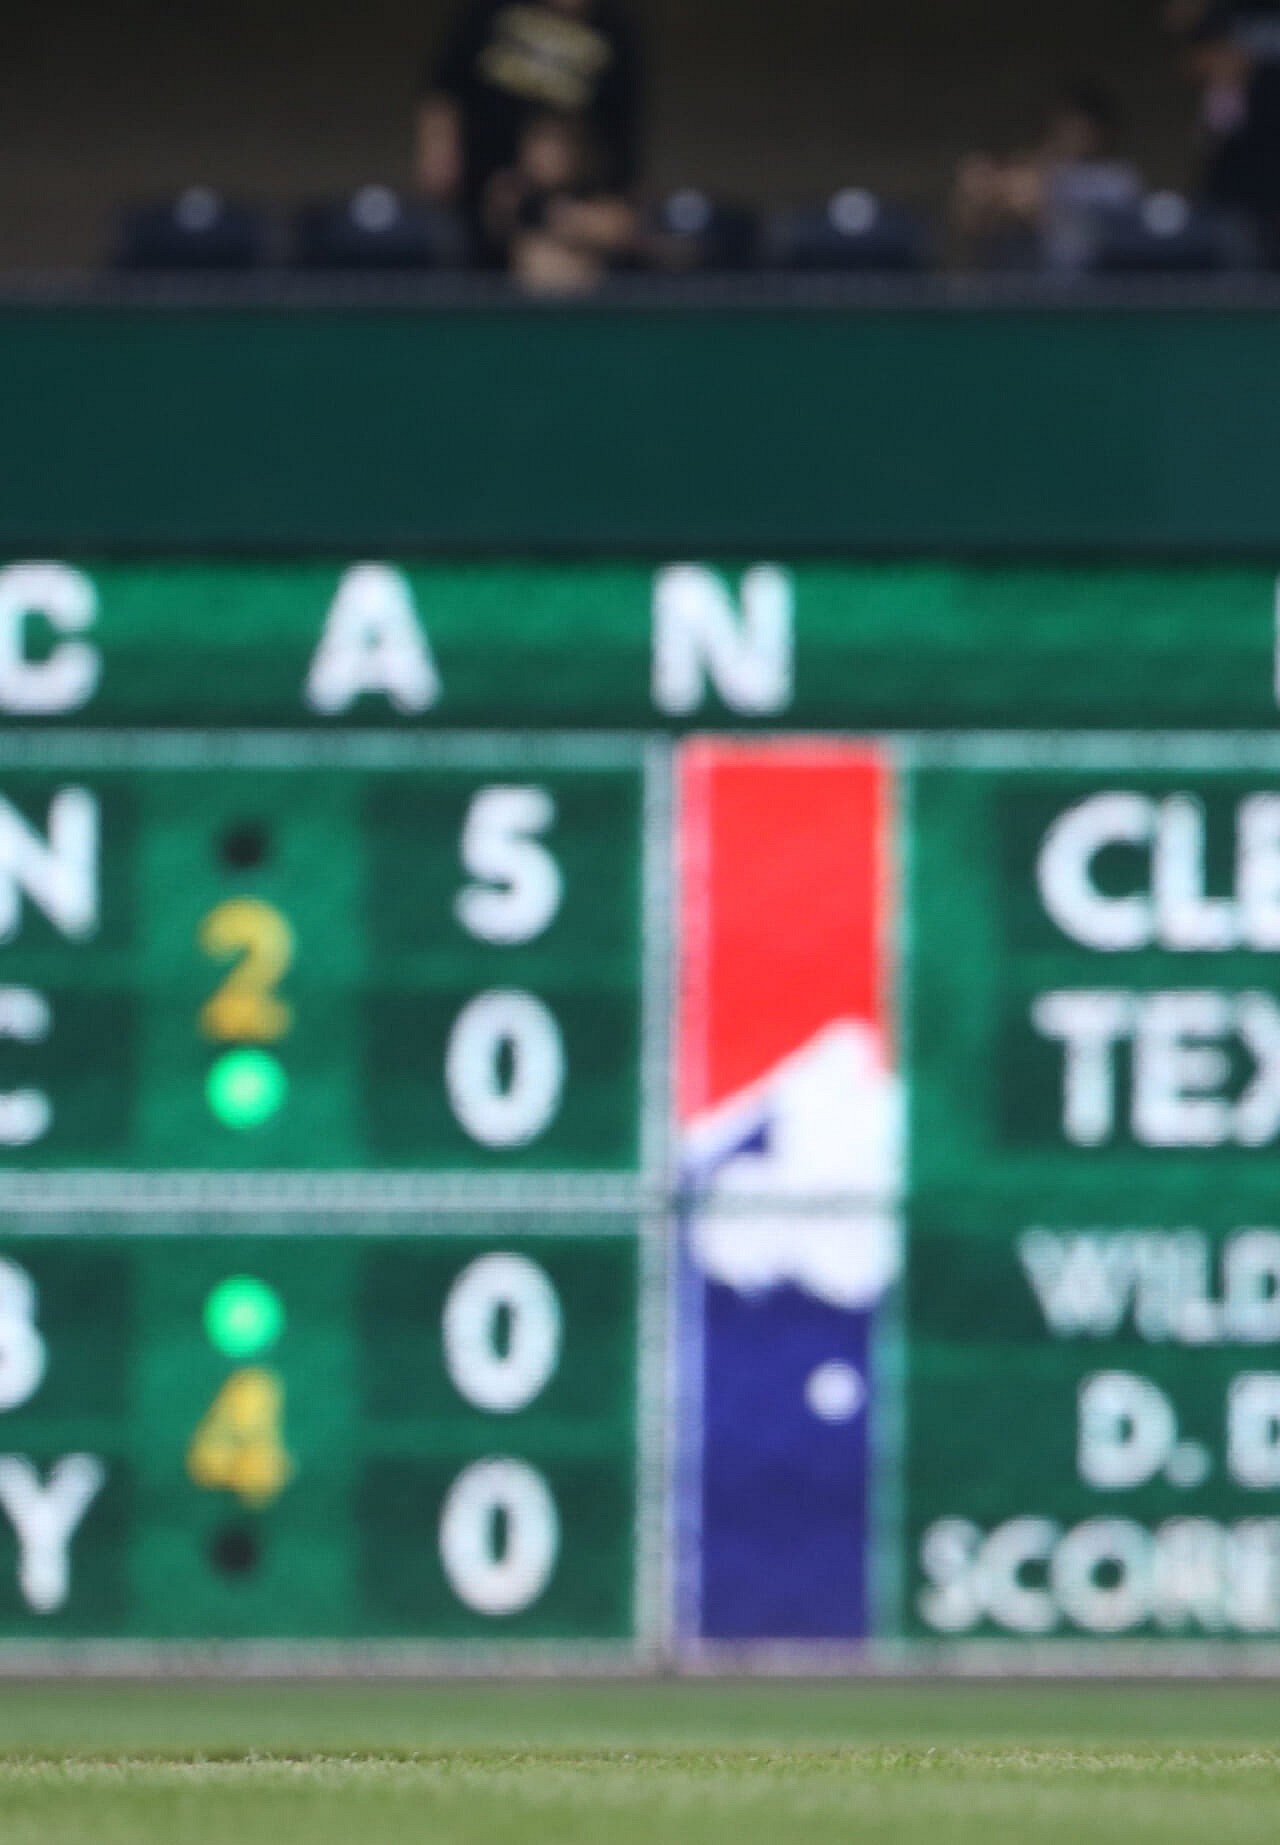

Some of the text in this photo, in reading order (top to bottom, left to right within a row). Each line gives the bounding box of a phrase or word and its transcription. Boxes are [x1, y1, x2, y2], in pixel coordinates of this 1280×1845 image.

[198, 899, 293, 1043] 2
[444, 988, 568, 1149] 0
[440, 1251, 563, 1414] 0
[185, 1364, 291, 1510] 4
[1076, 1368, 1213, 1491] D.
[0, 1452, 105, 1614] Y
[437, 1456, 562, 1617] 0
